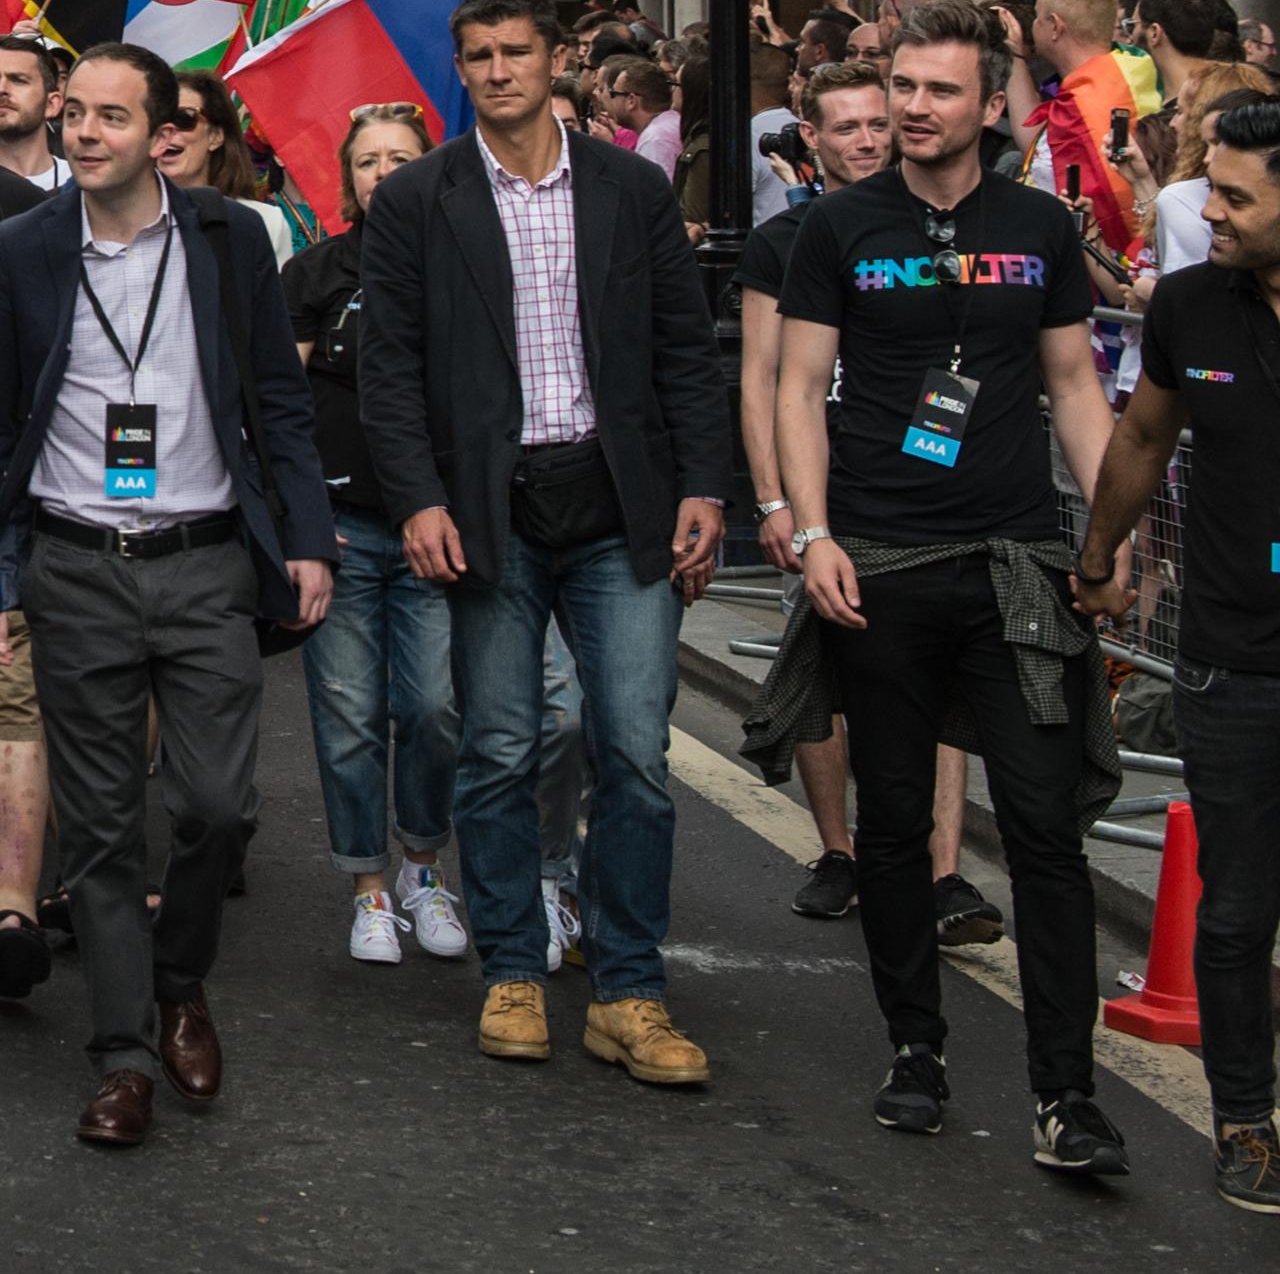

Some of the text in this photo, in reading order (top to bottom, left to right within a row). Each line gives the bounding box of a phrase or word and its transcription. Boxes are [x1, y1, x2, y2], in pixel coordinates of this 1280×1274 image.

[854, 252, 1045, 291] #NOILTER
[914, 437, 947, 456] AAA
[115, 476, 147, 489] AAA
